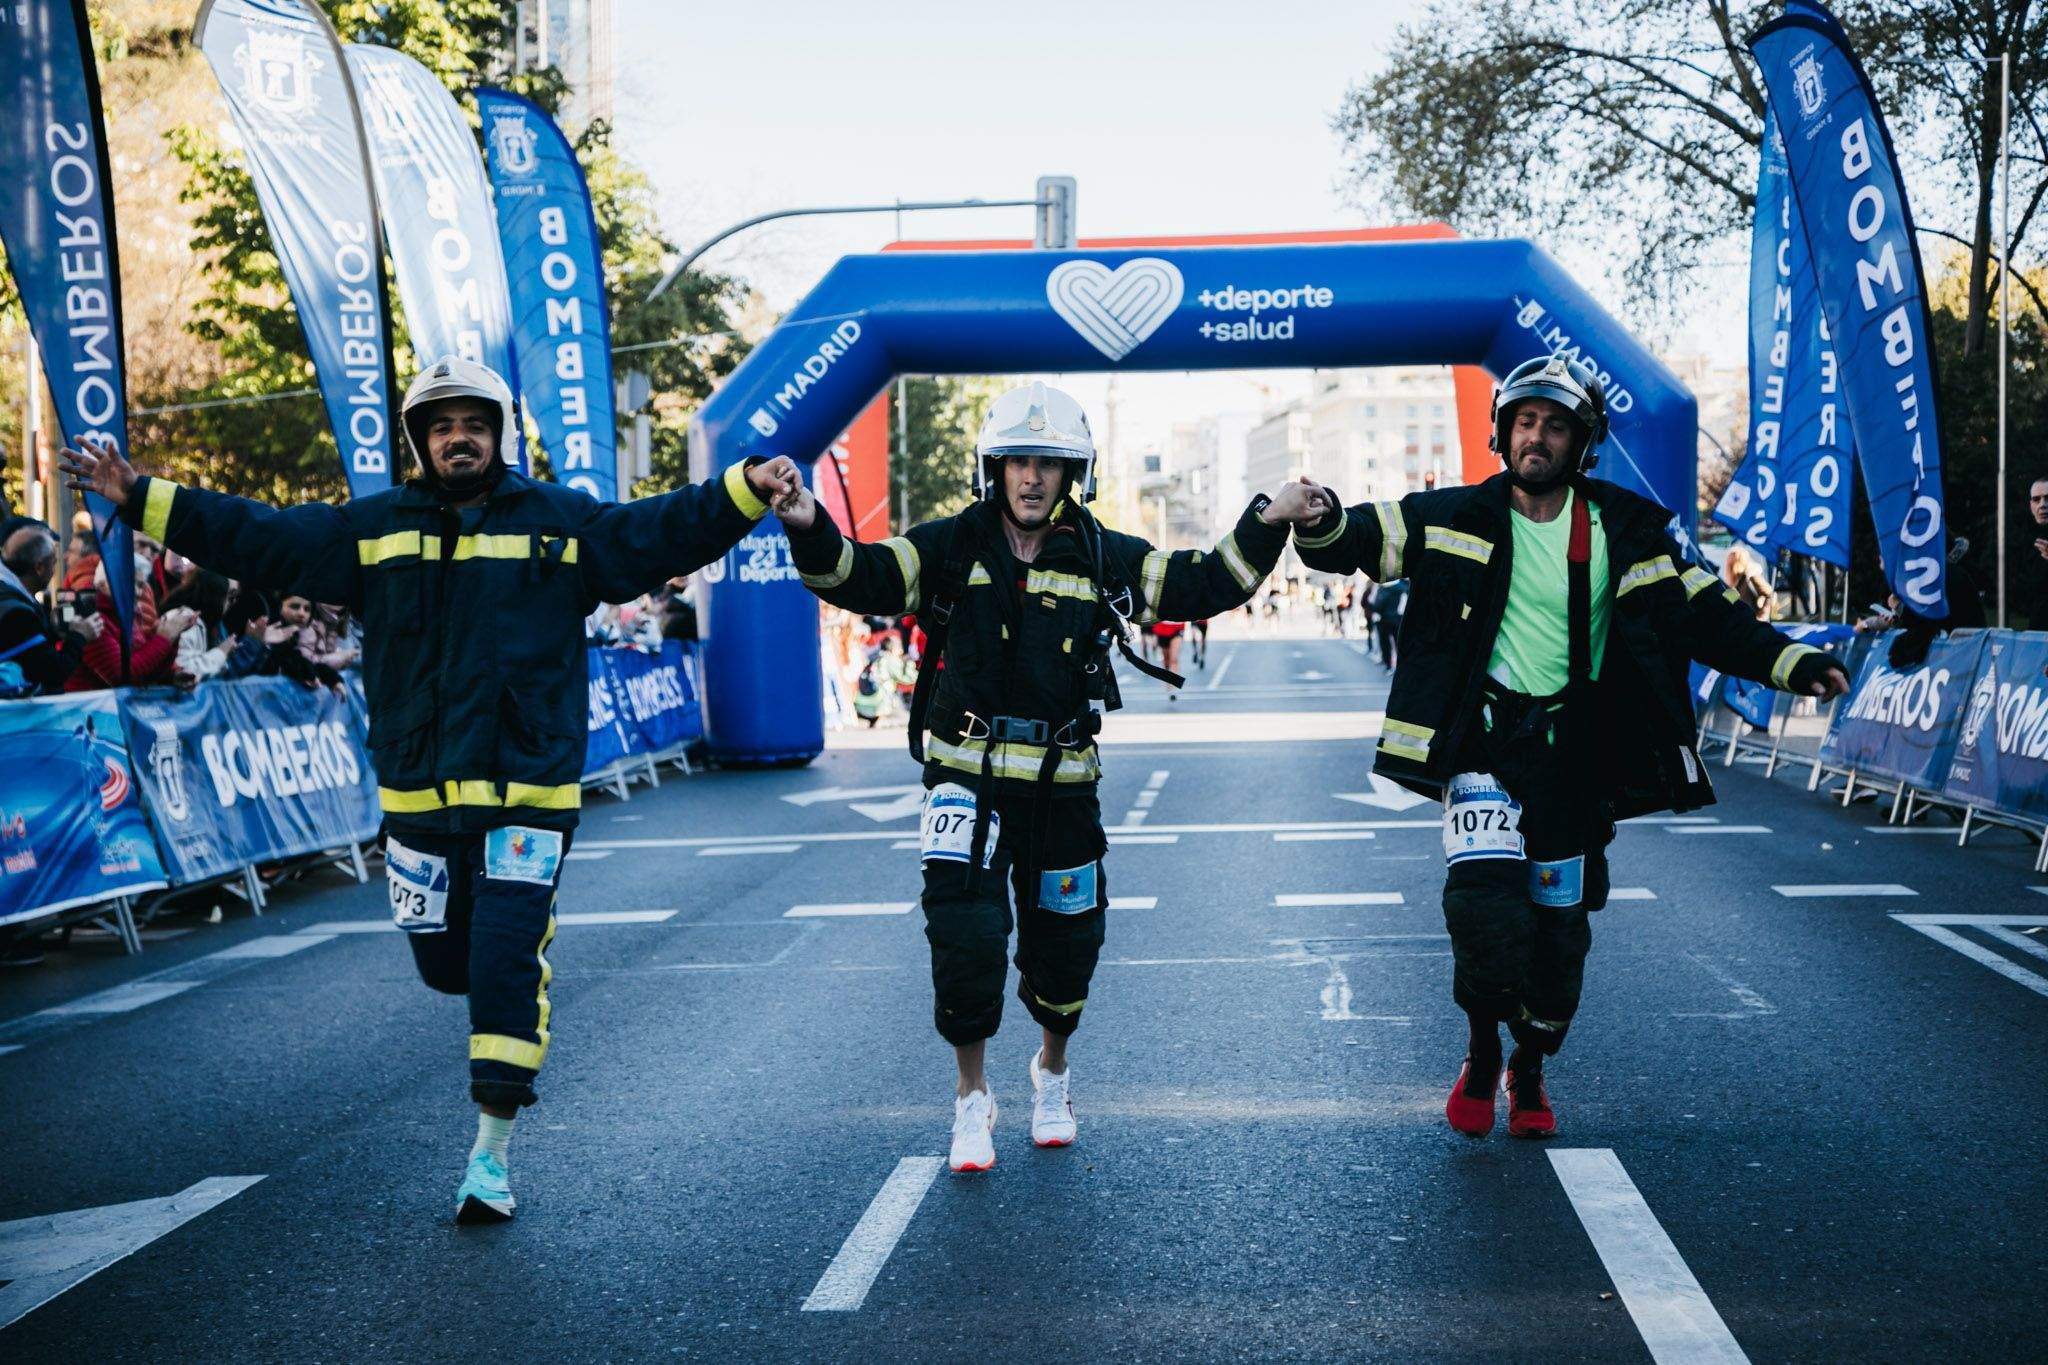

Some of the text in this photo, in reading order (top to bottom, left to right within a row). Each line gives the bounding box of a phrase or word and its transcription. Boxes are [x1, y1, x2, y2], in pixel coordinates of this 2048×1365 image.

[1197, 284, 1334, 315] +deporte
[1199, 315, 1295, 341] +salud
[775, 320, 861, 411] MADRID
[201, 720, 360, 808] BOMBEROS
[1451, 809, 1511, 835] 1072
